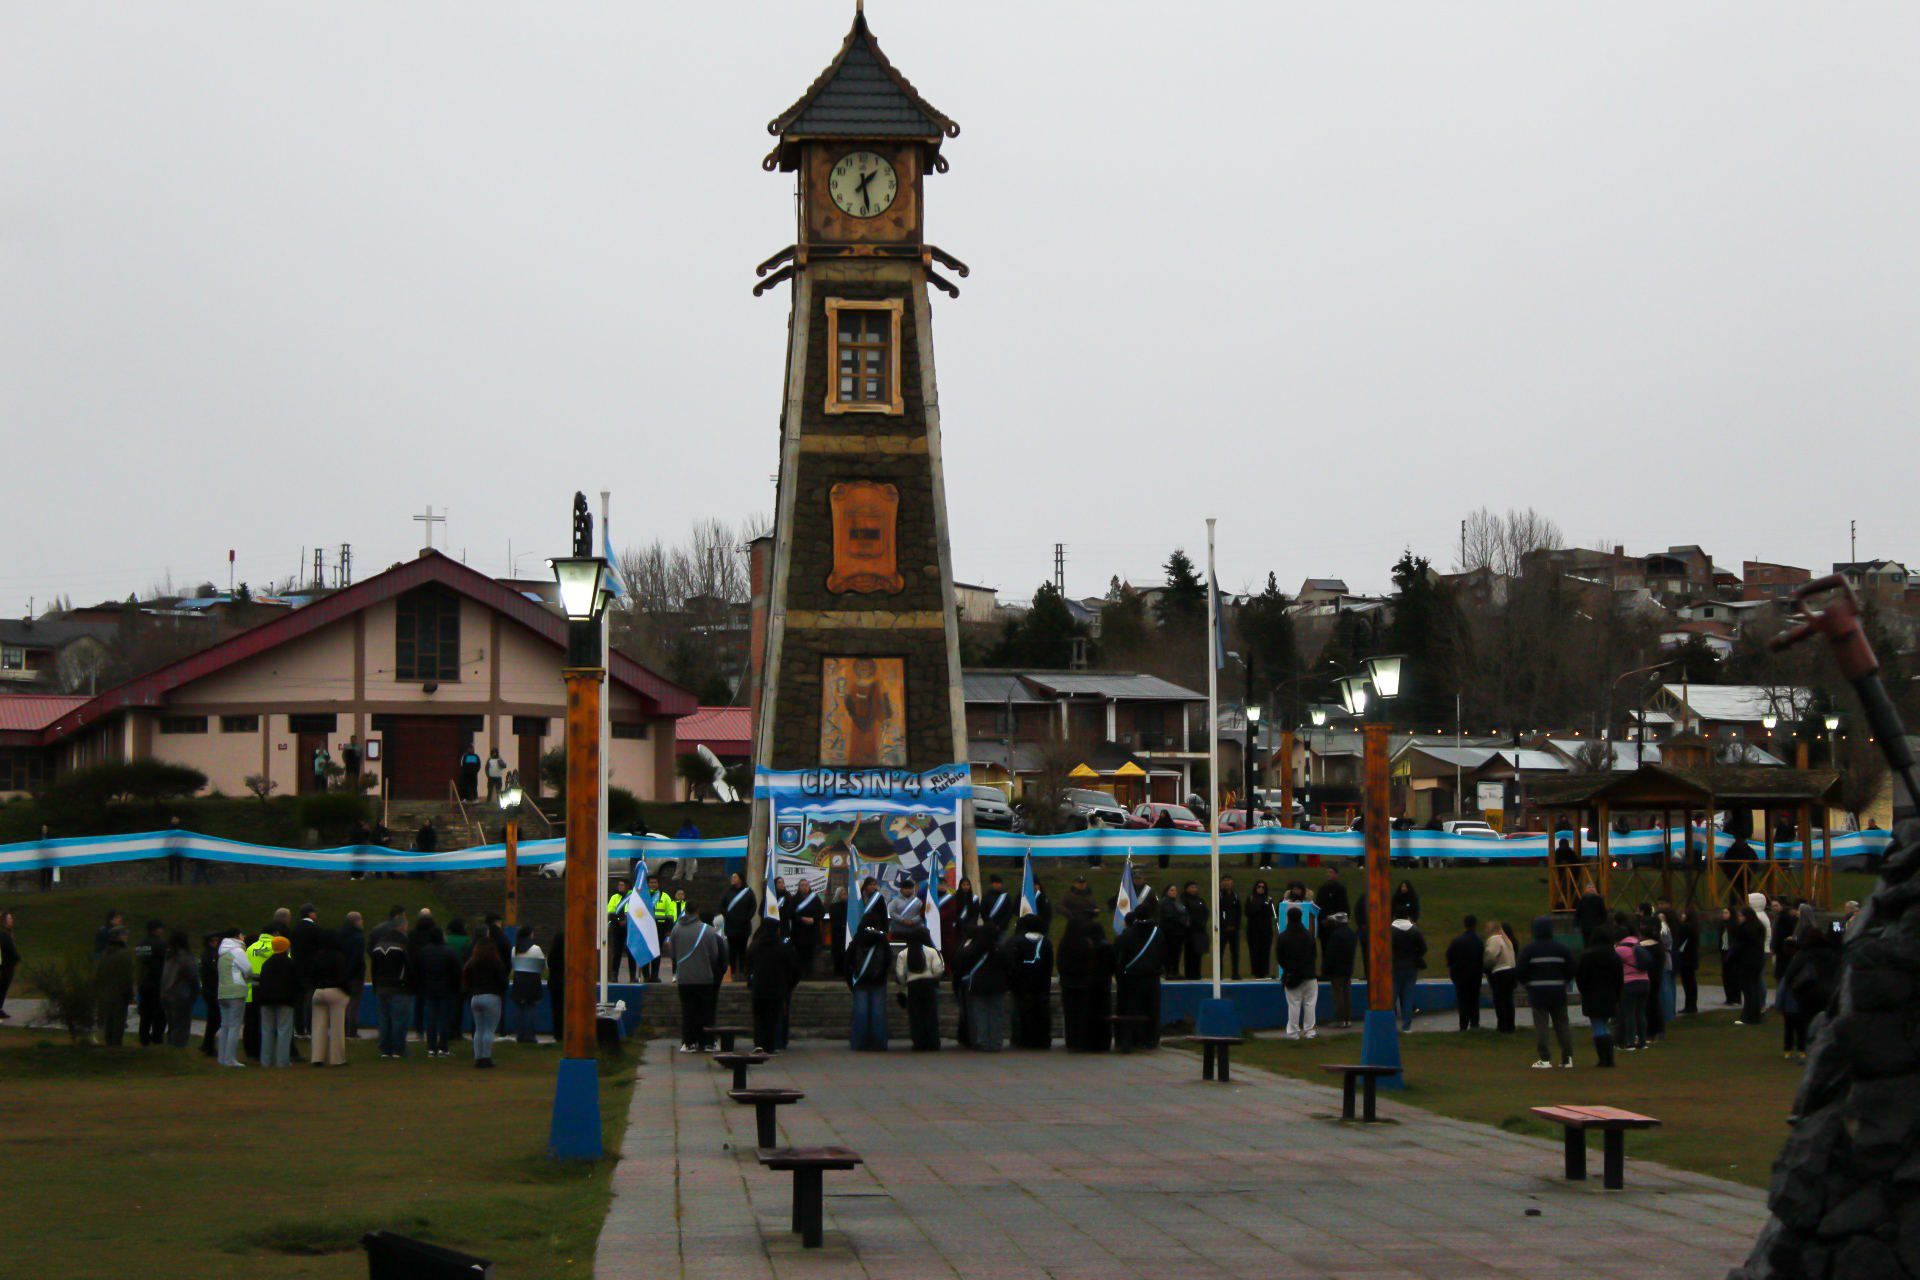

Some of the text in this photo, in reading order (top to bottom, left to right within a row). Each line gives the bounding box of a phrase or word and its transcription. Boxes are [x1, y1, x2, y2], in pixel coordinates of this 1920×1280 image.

[846, 158, 853, 166] 11
[859, 154, 868, 163] 12
[837, 167, 846, 176] 10
[885, 167, 890, 176] 2
[832, 181, 838, 189] 9
[888, 180, 895, 189] 3
[837, 194, 843, 203] 8
[884, 194, 890, 203] 4
[847, 203, 853, 212] 7
[860, 206, 866, 216] 6
[874, 203, 880, 212] 5
[801, 768, 863, 796] CPES
[904, 773, 920, 797] 4
[930, 772, 965, 794] Turbio
